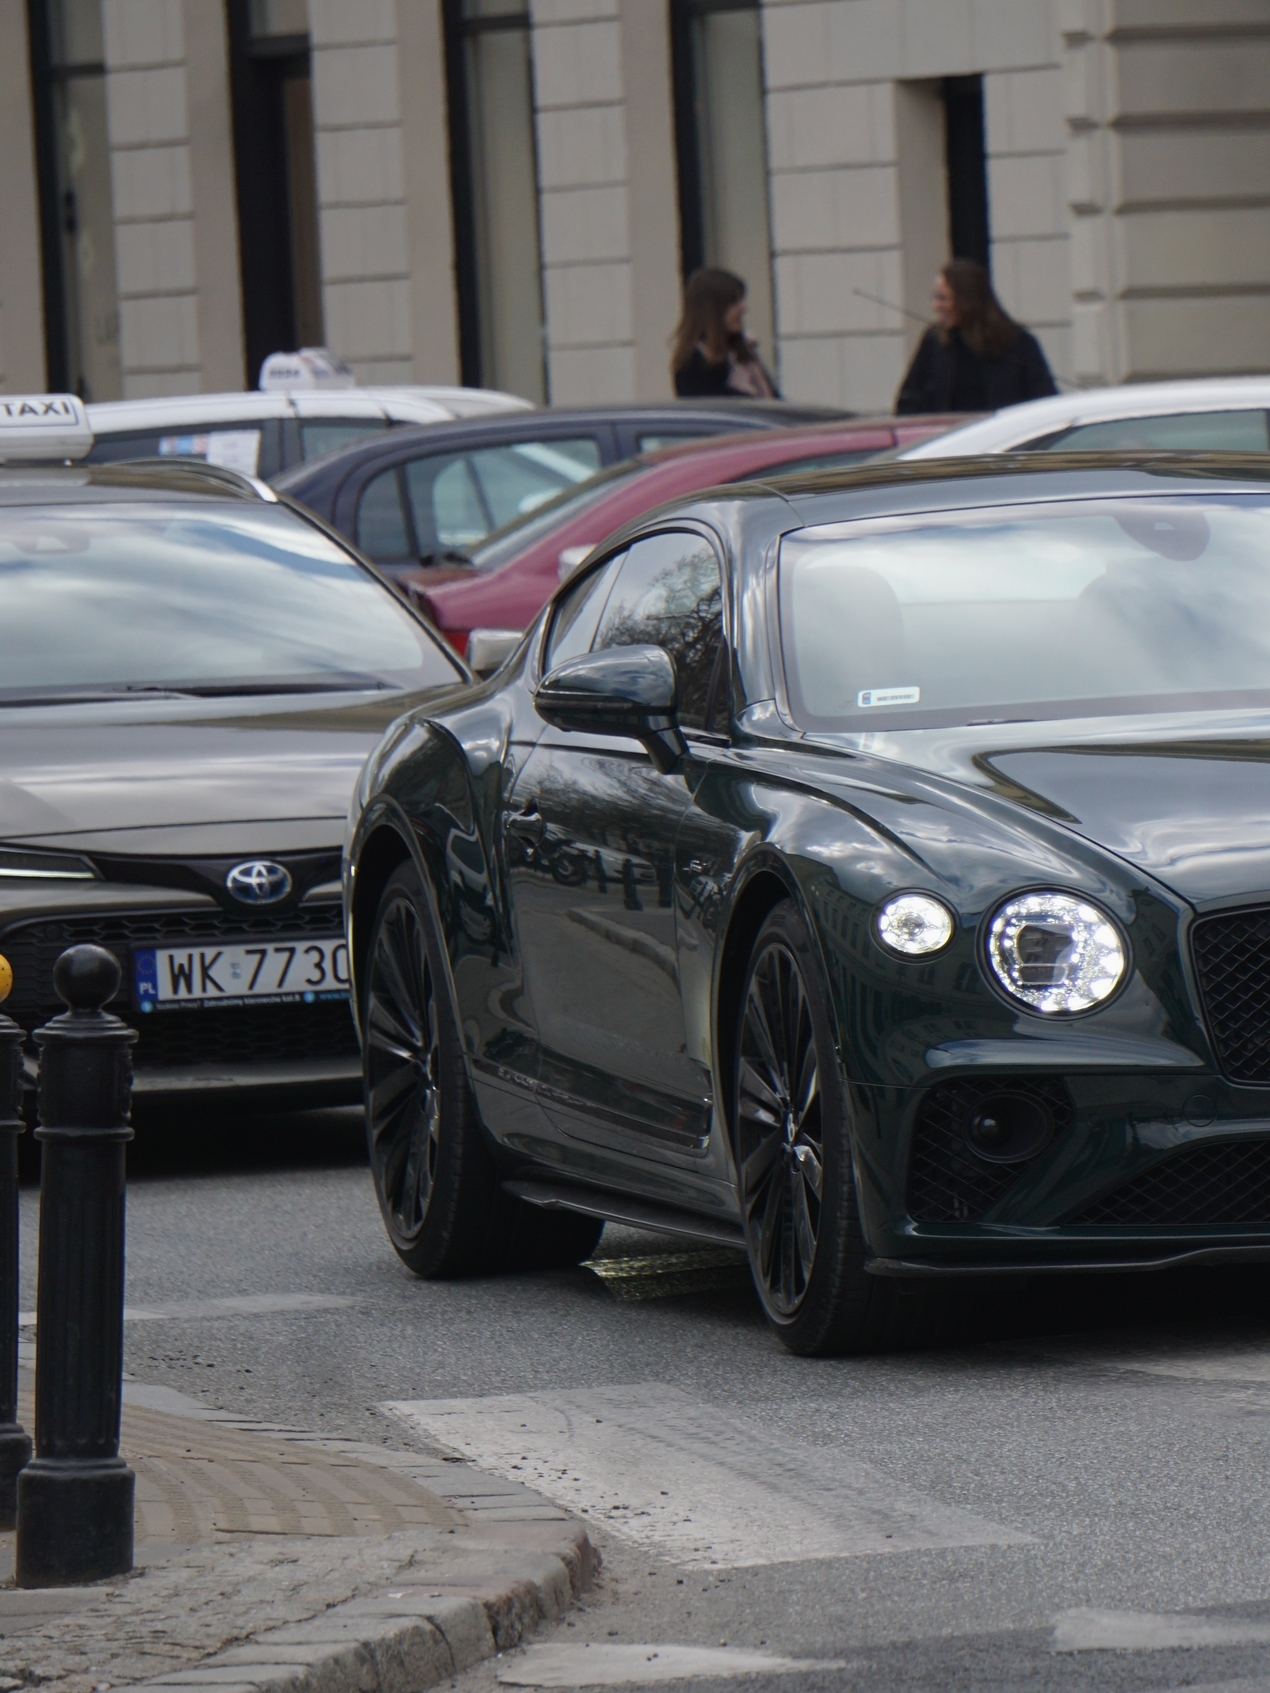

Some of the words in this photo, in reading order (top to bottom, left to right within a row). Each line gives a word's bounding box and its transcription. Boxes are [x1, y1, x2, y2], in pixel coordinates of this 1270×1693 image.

[3, 401, 70, 416] TAXI
[168, 951, 226, 996] WK
[139, 982, 156, 995] PL
